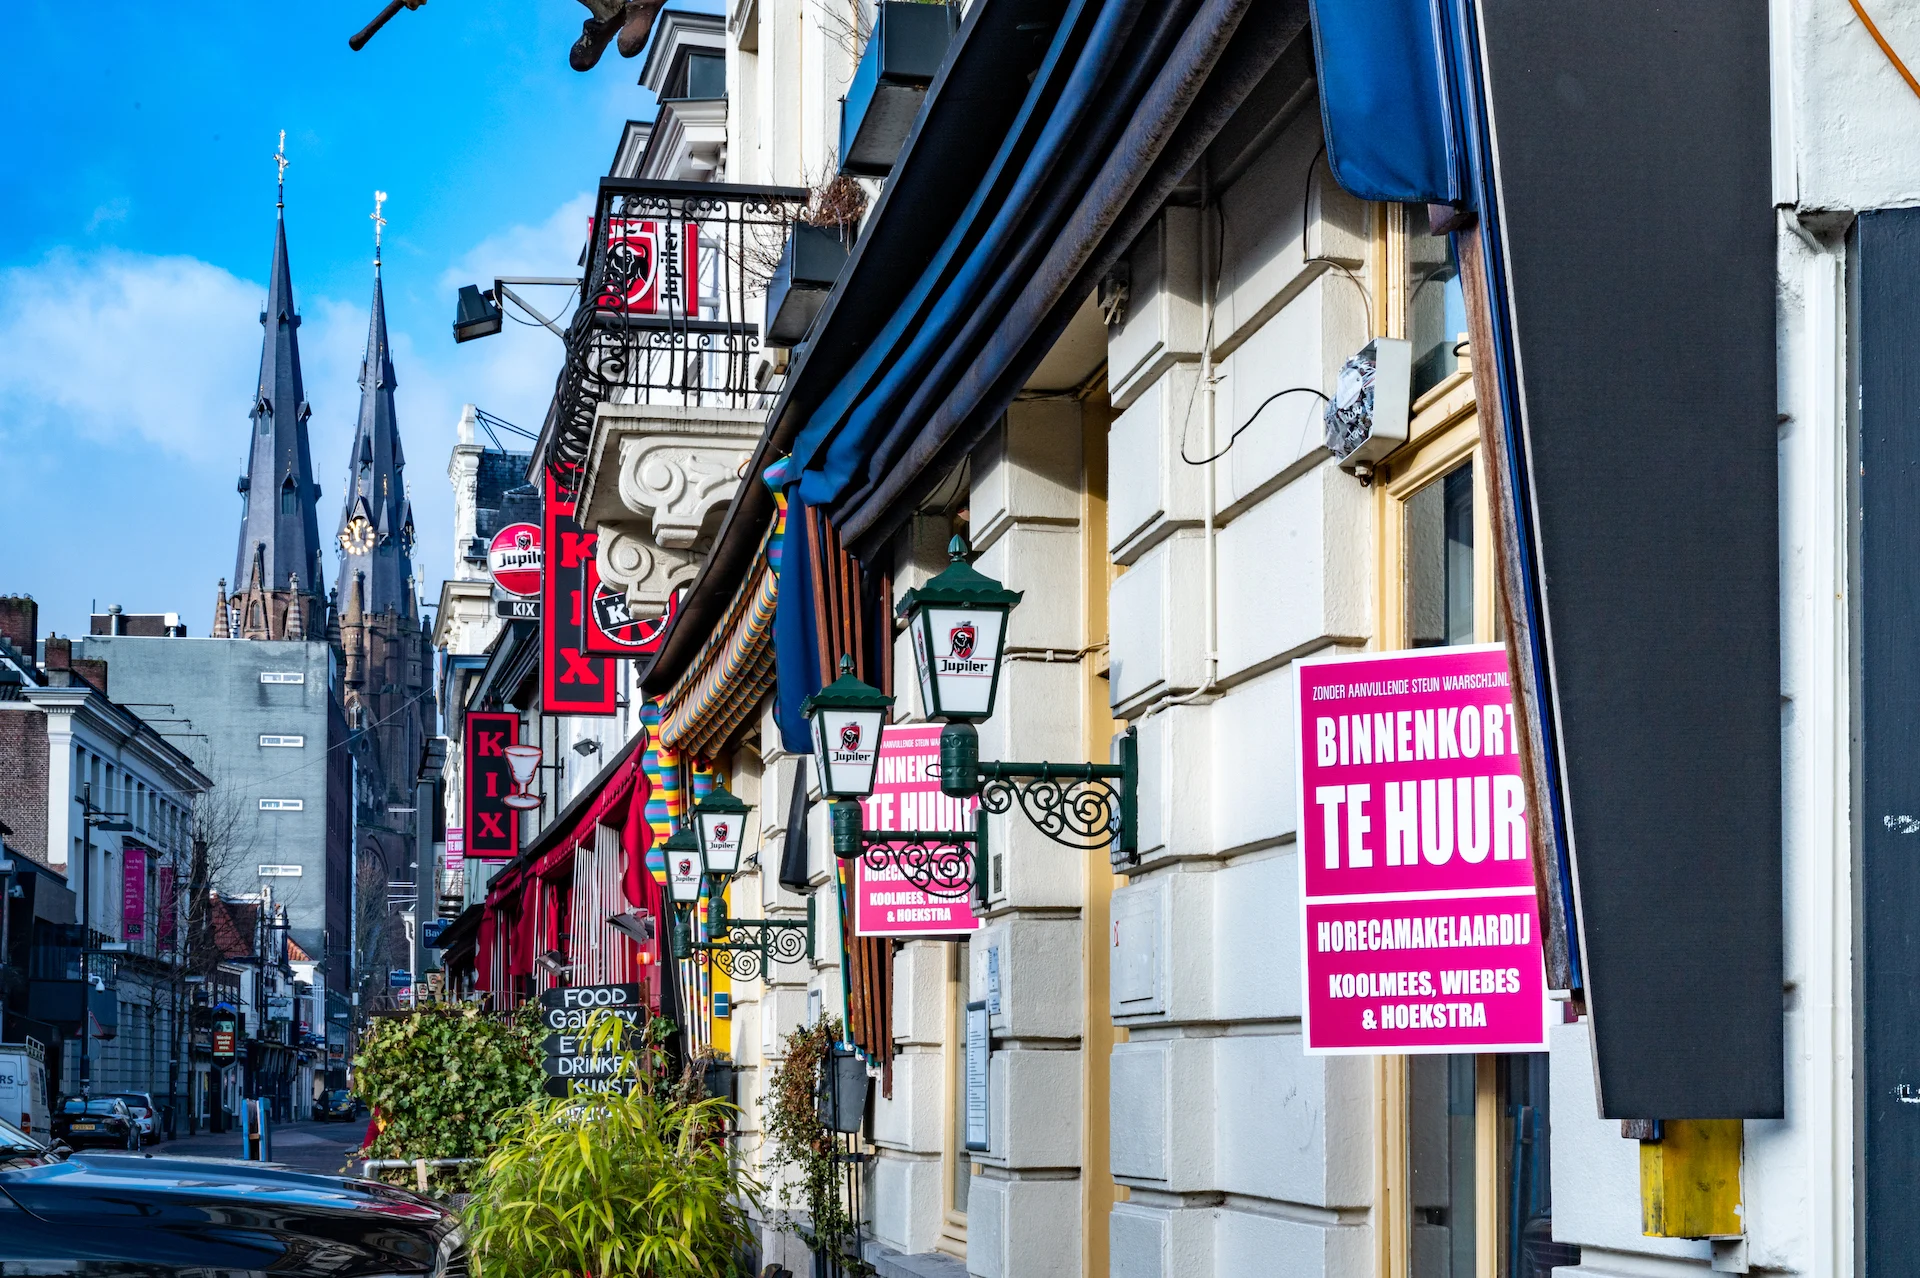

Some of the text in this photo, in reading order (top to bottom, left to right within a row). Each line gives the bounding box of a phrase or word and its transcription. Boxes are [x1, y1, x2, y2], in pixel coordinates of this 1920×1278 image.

[660, 225, 682, 306] Jupiler
[512, 602, 536, 616] KIX
[940, 660, 988, 674] Jupiler
[1313, 672, 1510, 701] ZONDER AANVULLENDE STEUN WAARSCHIJNL
[832, 751, 871, 763] Jupiler
[874, 754, 941, 784] INNENK
[478, 731, 506, 838] KIX
[866, 793, 895, 832] TE
[1315, 774, 1527, 870] TE HUUR
[709, 842, 736, 850] Jupiler
[869, 890, 926, 906] KOOLMEES,
[886, 907, 951, 922] & HOEKSTRA
[1317, 913, 1531, 953] HORECAMAKELAARDIJ
[1329, 968, 1521, 998] KOOLMEES, WIEBES
[563, 988, 627, 1008] FOOD
[1361, 1002, 1487, 1030] & HOEKSTRA
[0, 1075, 14, 1085] RS
